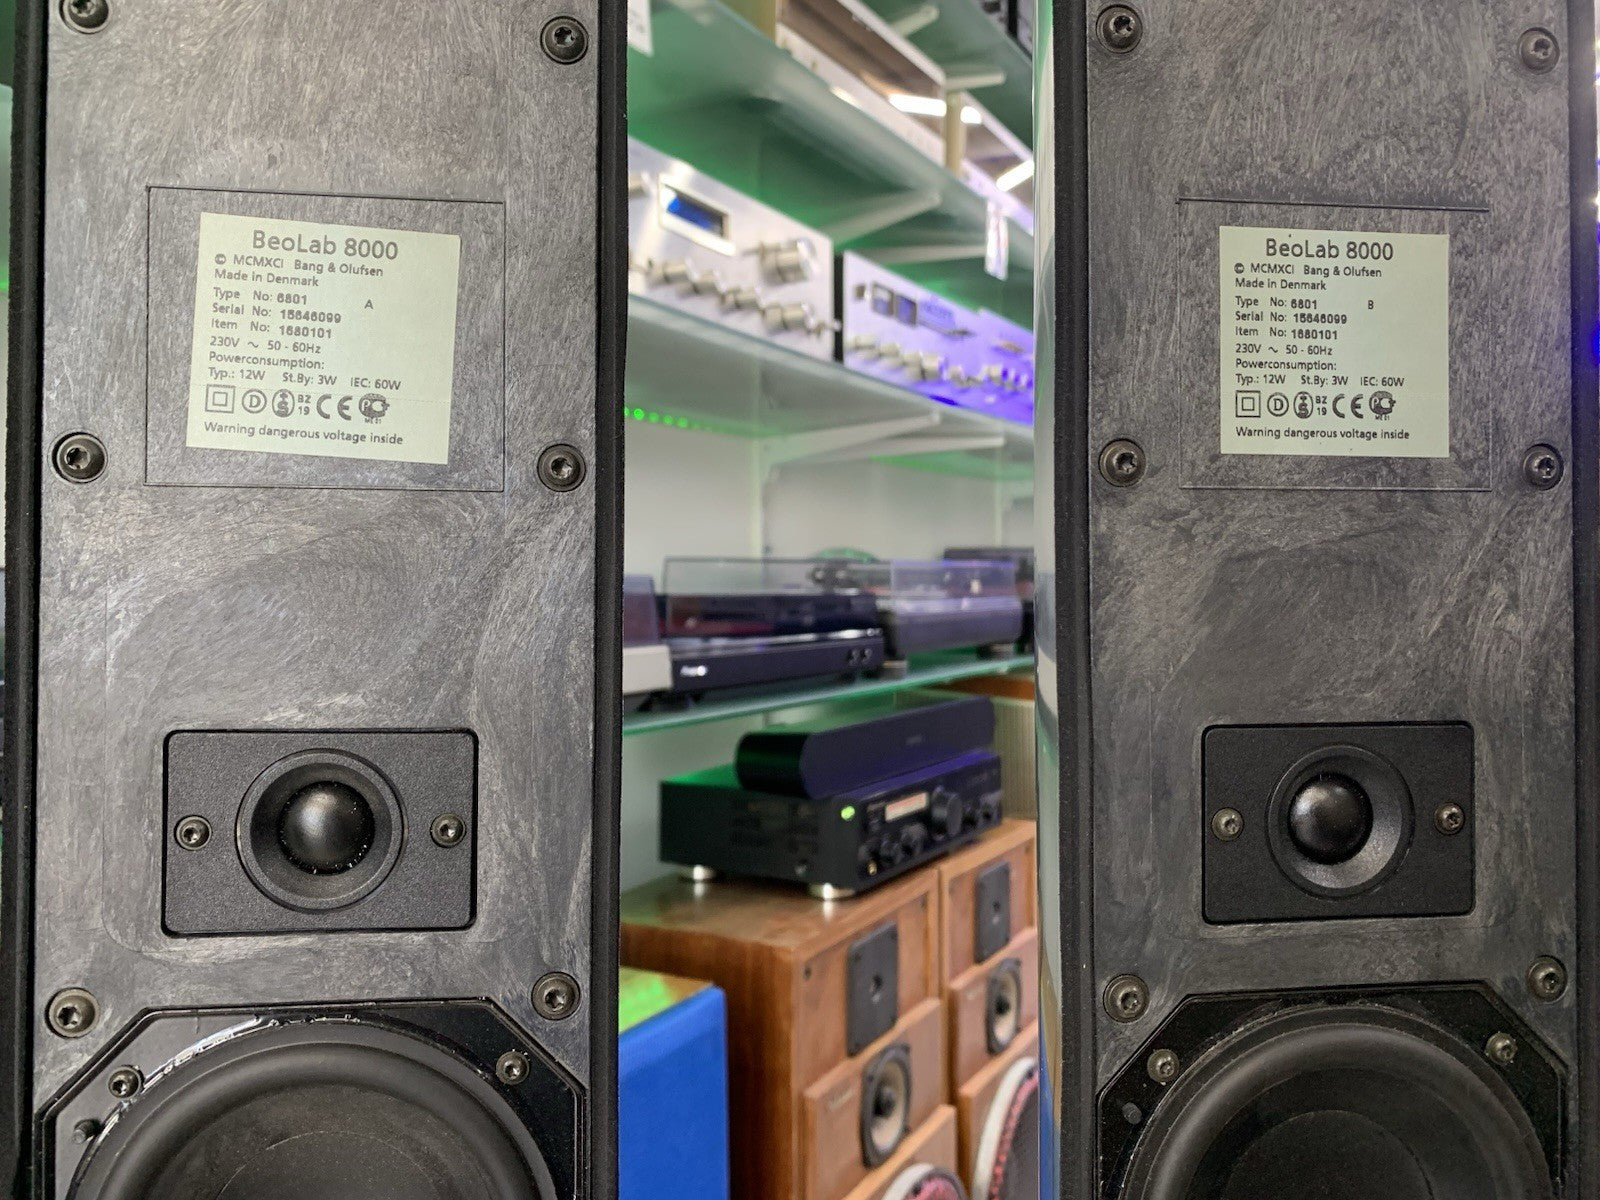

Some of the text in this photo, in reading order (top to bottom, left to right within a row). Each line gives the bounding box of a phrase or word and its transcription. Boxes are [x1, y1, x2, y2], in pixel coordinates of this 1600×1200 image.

[252, 229, 399, 260] BeoLab 8000
[1266, 238, 1394, 260] BeoLab 8000
[233, 254, 284, 268] MCMXCI
[294, 259, 324, 274] Bang
[328, 262, 335, 273] &
[339, 263, 383, 276] Olufsen
[1250, 263, 1295, 274] MCMXCI
[1304, 265, 1330, 278] Bang
[1333, 266, 1340, 276] &
[1344, 266, 1382, 277] Olufsen
[214, 269, 319, 287] Made in Denmark
[1235, 278, 1326, 291] Made in Denmark
[213, 287, 373, 309] Type No: 6801 A
[1236, 296, 1374, 310] Type No: 6801 B
[212, 303, 244, 315] Serial
[252, 306, 272, 317] No:
[1236, 312, 1263, 321] Serial
[1270, 312, 1287, 322] No:
[211, 319, 332, 339] Item No: 1680101
[1236, 326, 1338, 340] Item No: 1680101
[210, 336, 240, 348] 230V
[267, 340, 281, 350] 50
[292, 342, 321, 354] 60Hz
[1236, 344, 1262, 353] 230V
[1285, 345, 1297, 354] 50
[1307, 345, 1333, 355] 60Hz
[209, 352, 325, 370] Powerconsumption:
[1236, 359, 1337, 371] Powerconsumption:
[239, 369, 265, 381] 12W
[283, 372, 314, 385] St.By:
[318, 374, 337, 385] 3W
[350, 377, 371, 388] IEC:
[375, 379, 401, 390] 60W
[1263, 375, 1286, 384] 12W
[1301, 375, 1328, 387] St.By:
[1331, 376, 1349, 385] 3W
[1360, 377, 1378, 386] IEC:
[1381, 377, 1405, 387] 60W
[298, 406, 310, 415] 19
[316, 394, 353, 420] CE
[1316, 407, 1327, 416] 19
[1332, 393, 1364, 419] CE
[204, 422, 403, 445] Warning dangerous voltage inside
[1236, 427, 1409, 441] Warning dangerous voltage inside
